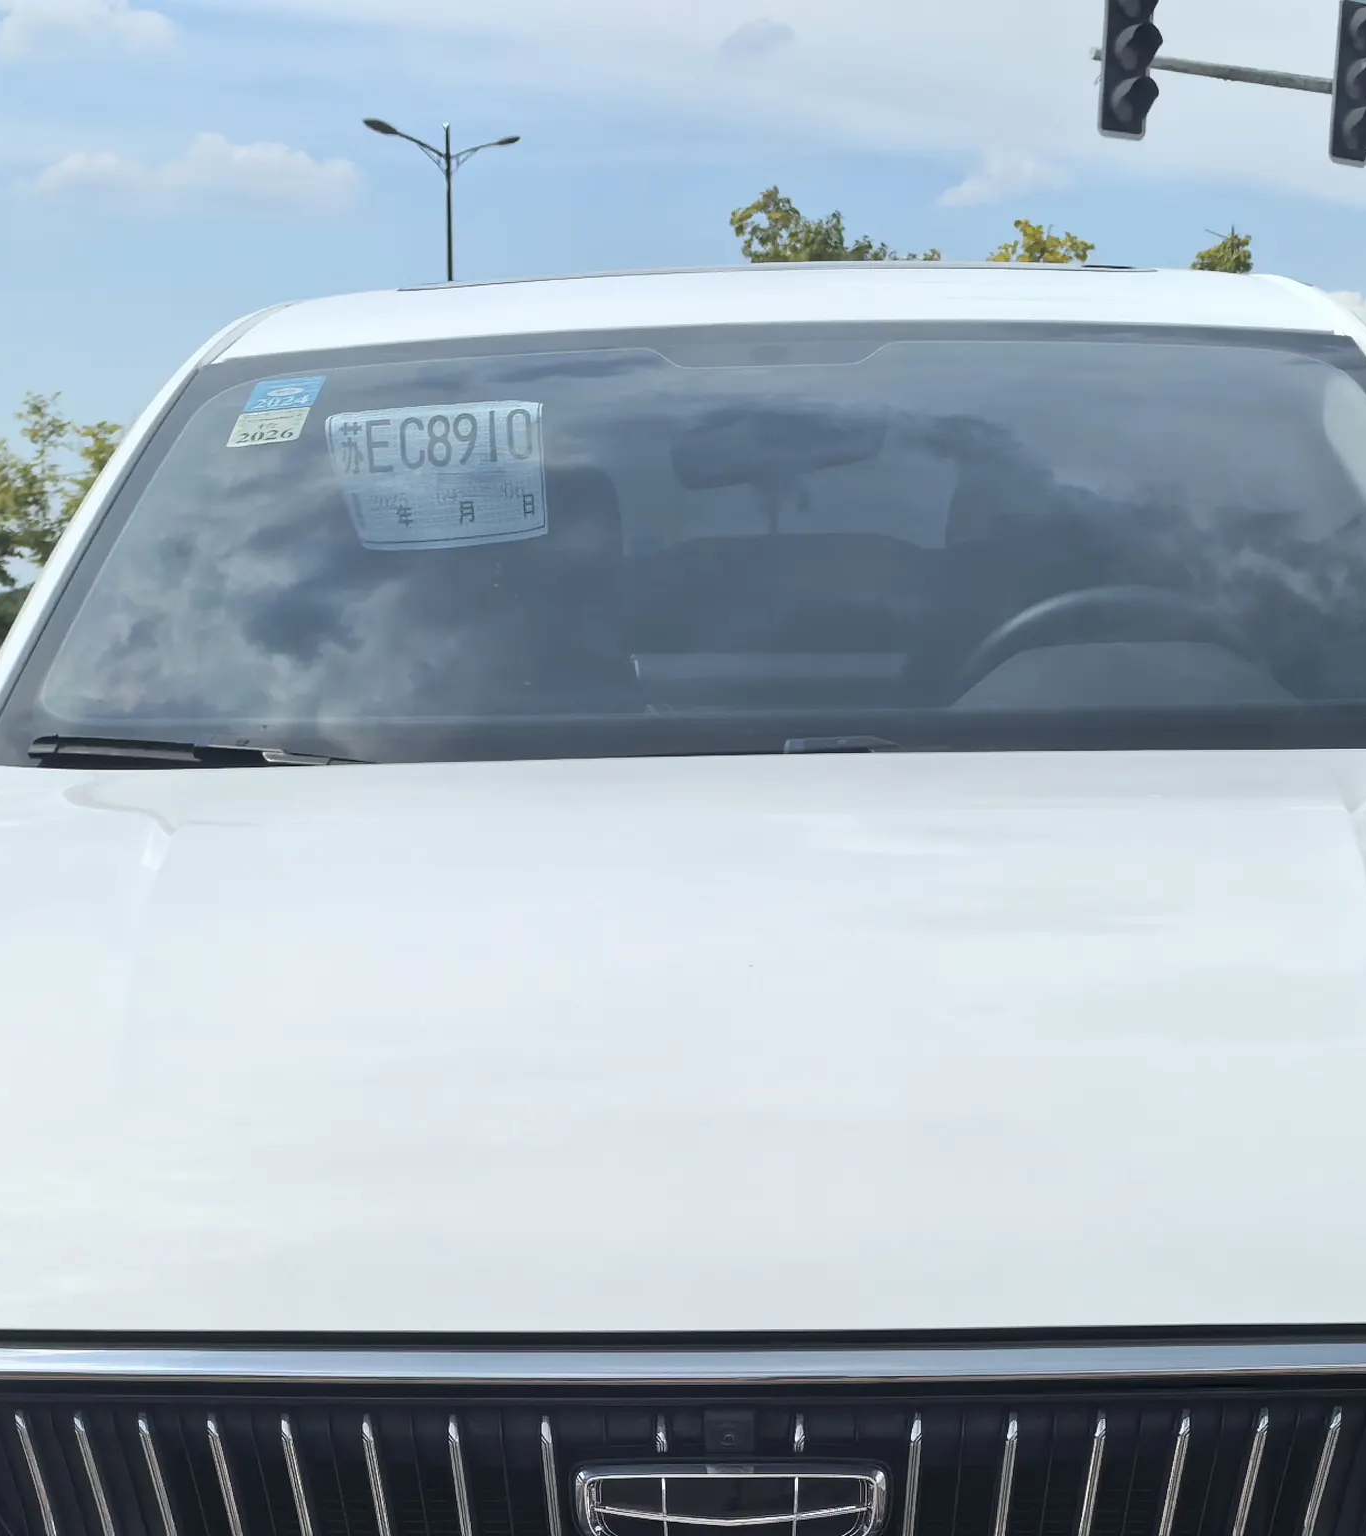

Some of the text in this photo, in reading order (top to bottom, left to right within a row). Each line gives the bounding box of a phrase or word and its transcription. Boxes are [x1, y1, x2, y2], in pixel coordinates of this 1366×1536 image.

[252, 394, 310, 409] 2024
[235, 427, 295, 444] 2026
[459, 500, 475, 524] 月
[523, 493, 535, 517] 日
